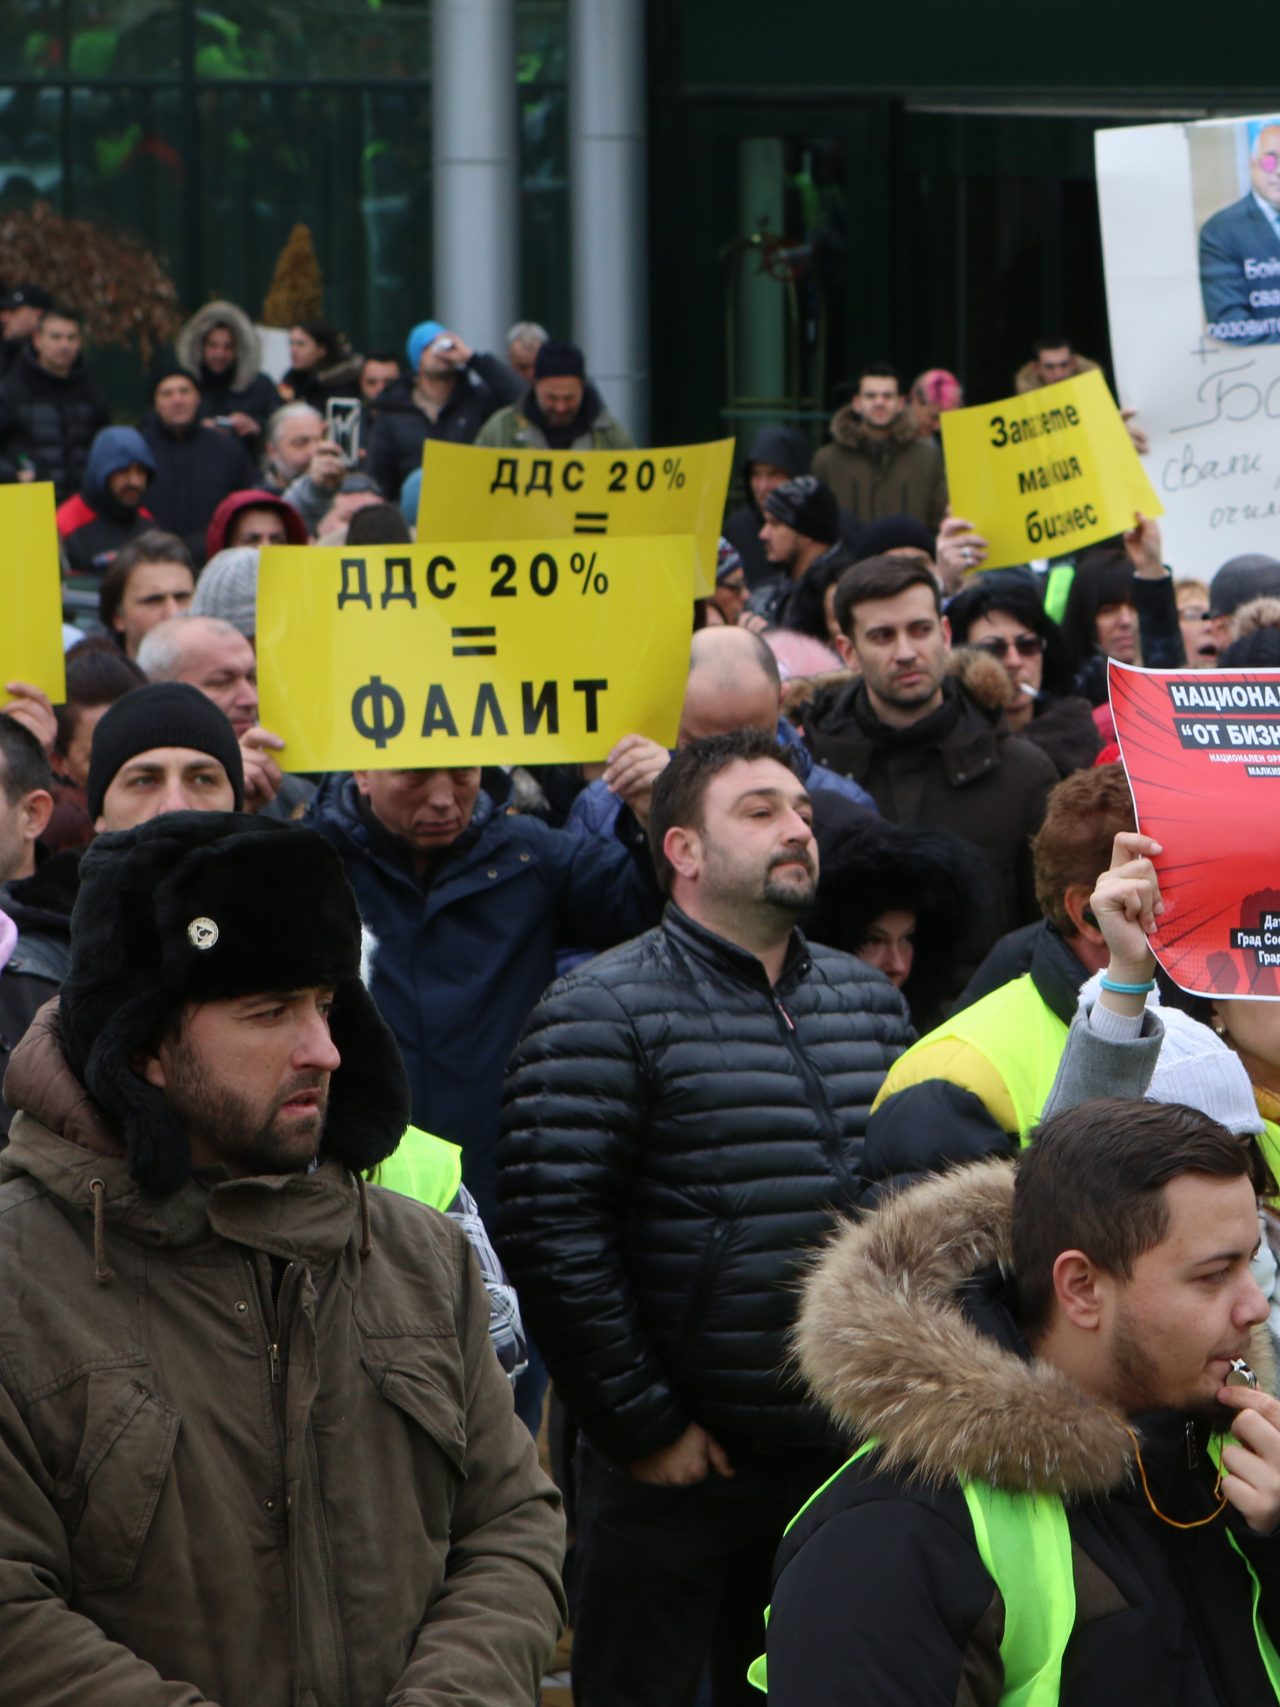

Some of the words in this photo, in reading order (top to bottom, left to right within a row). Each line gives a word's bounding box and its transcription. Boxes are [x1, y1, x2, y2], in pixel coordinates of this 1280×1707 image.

[490, 458, 585, 497] ДДС
[607, 457, 686, 492] 20%
[337, 555, 457, 611] ДДС
[490, 552, 609, 598] 20%
[351, 674, 609, 749] ФАЛИТ
[1208, 753, 1266, 764] НАЦИОНАЛЕН
[1237, 932, 1262, 947] Град
